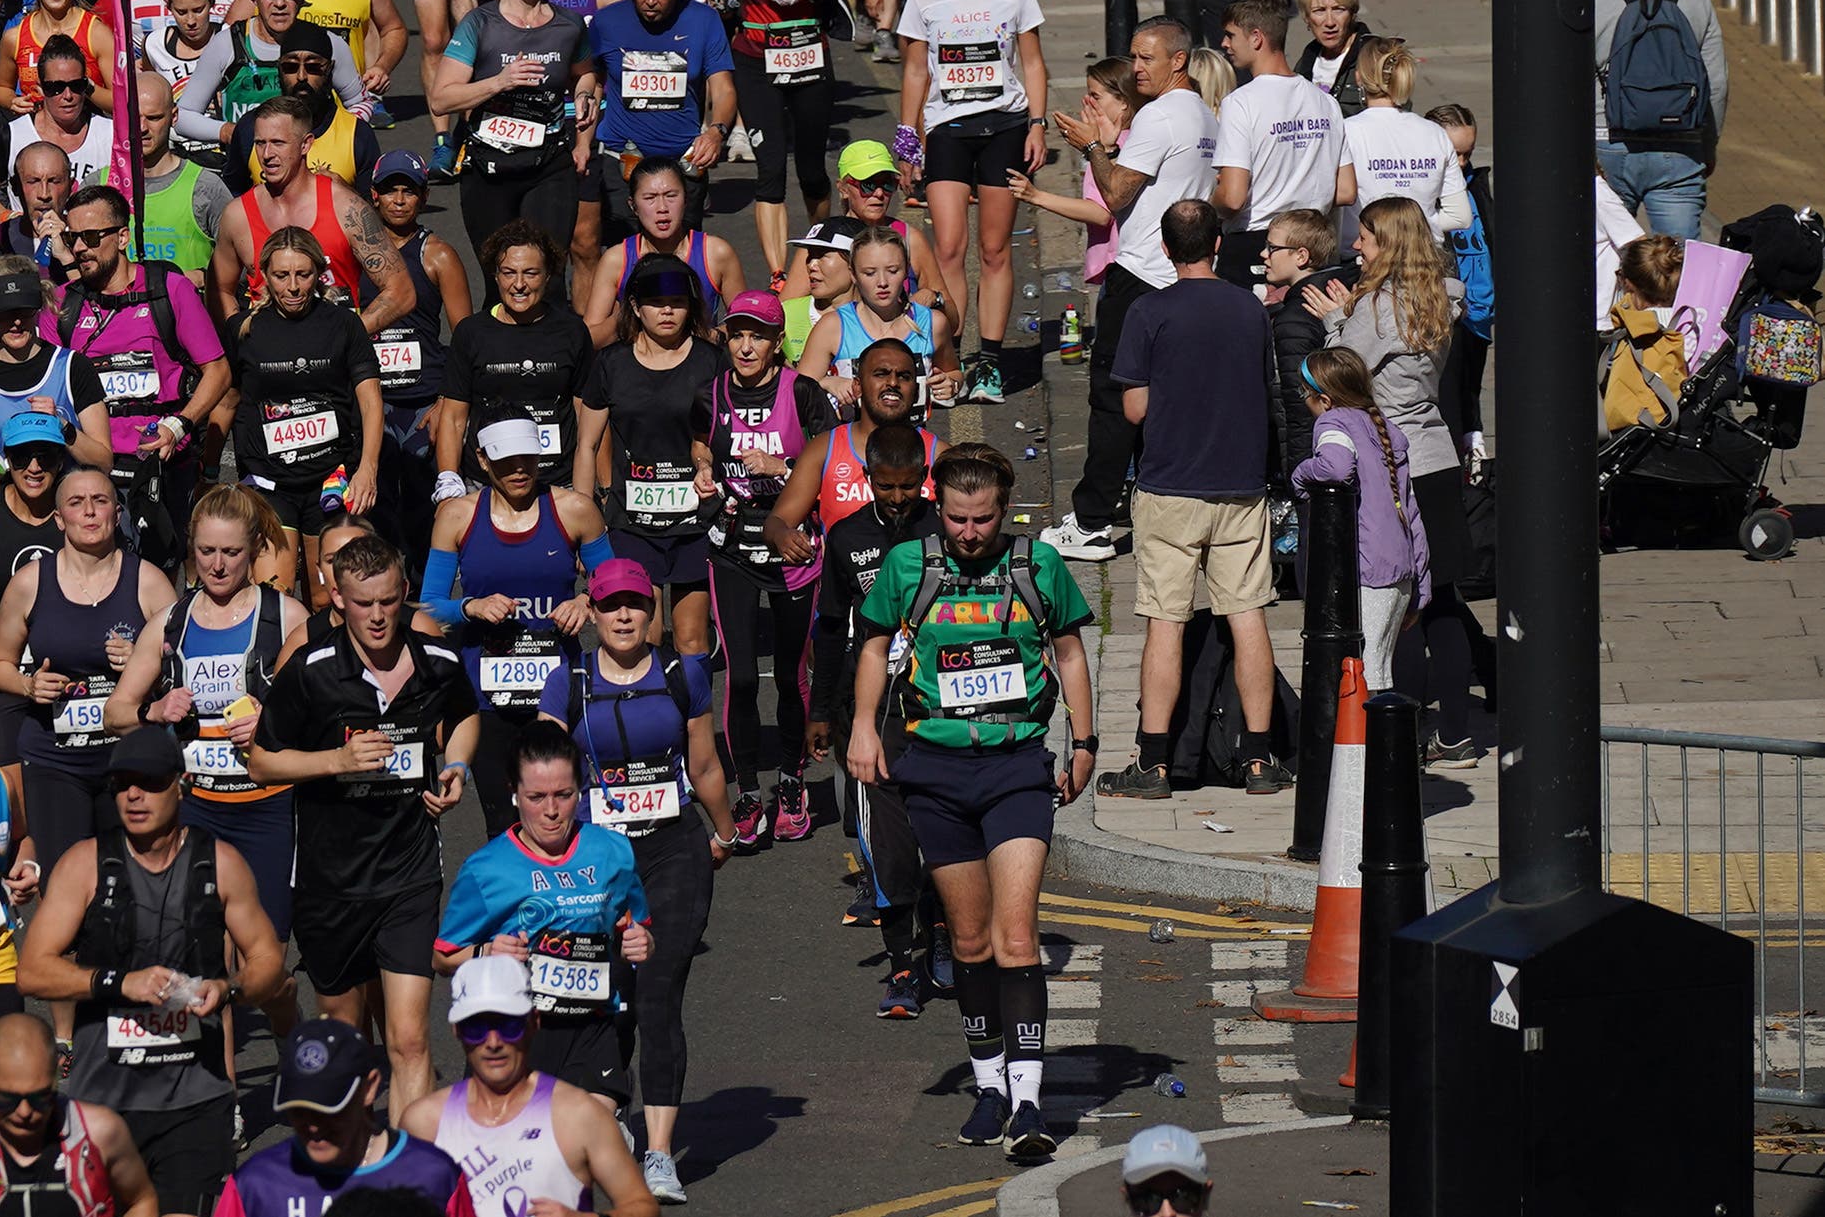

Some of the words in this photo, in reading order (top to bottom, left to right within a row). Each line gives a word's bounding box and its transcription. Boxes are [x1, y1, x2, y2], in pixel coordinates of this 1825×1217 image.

[304, 12, 361, 28] DogsTrust
[952, 10, 991, 24] ALICE
[773, 50, 816, 68] 46399
[942, 48, 964, 60] tcs
[629, 74, 678, 93] 49301
[946, 65, 995, 84] 48379
[487, 120, 536, 142] 45271
[1270, 119, 1304, 135] JORDAN
[1307, 118, 1330, 131] BARR
[1368, 159, 1407, 171] JORDAN
[1411, 158, 1437, 170] BARR
[259, 360, 294, 373] RUNNING
[309, 359, 331, 370] SKULL
[486, 363, 520, 375] RUNNING
[536, 362, 557, 373] SKULL
[272, 417, 327, 445] 44907
[730, 432, 780, 455] ZENA
[632, 463, 653, 479] tcs
[634, 484, 689, 506] 26717
[942, 650, 971, 668] tcs
[973, 648, 1014, 659] CONSULTANCY
[974, 656, 1002, 665] SERVICES
[193, 661, 245, 680] Alex
[491, 661, 549, 683] 12890
[191, 678, 230, 694] Brain
[951, 671, 1013, 698] 15917
[627, 767, 669, 776] CONSULTANCY
[628, 774, 657, 783] SERVICES
[538, 963, 599, 993] 15585
[118, 1010, 188, 1038] 48549
[1492, 1009, 1519, 1029] 2854
[146, 1051, 163, 1063] new
[164, 1050, 195, 1061] balance
[487, 1157, 534, 1195] purple
